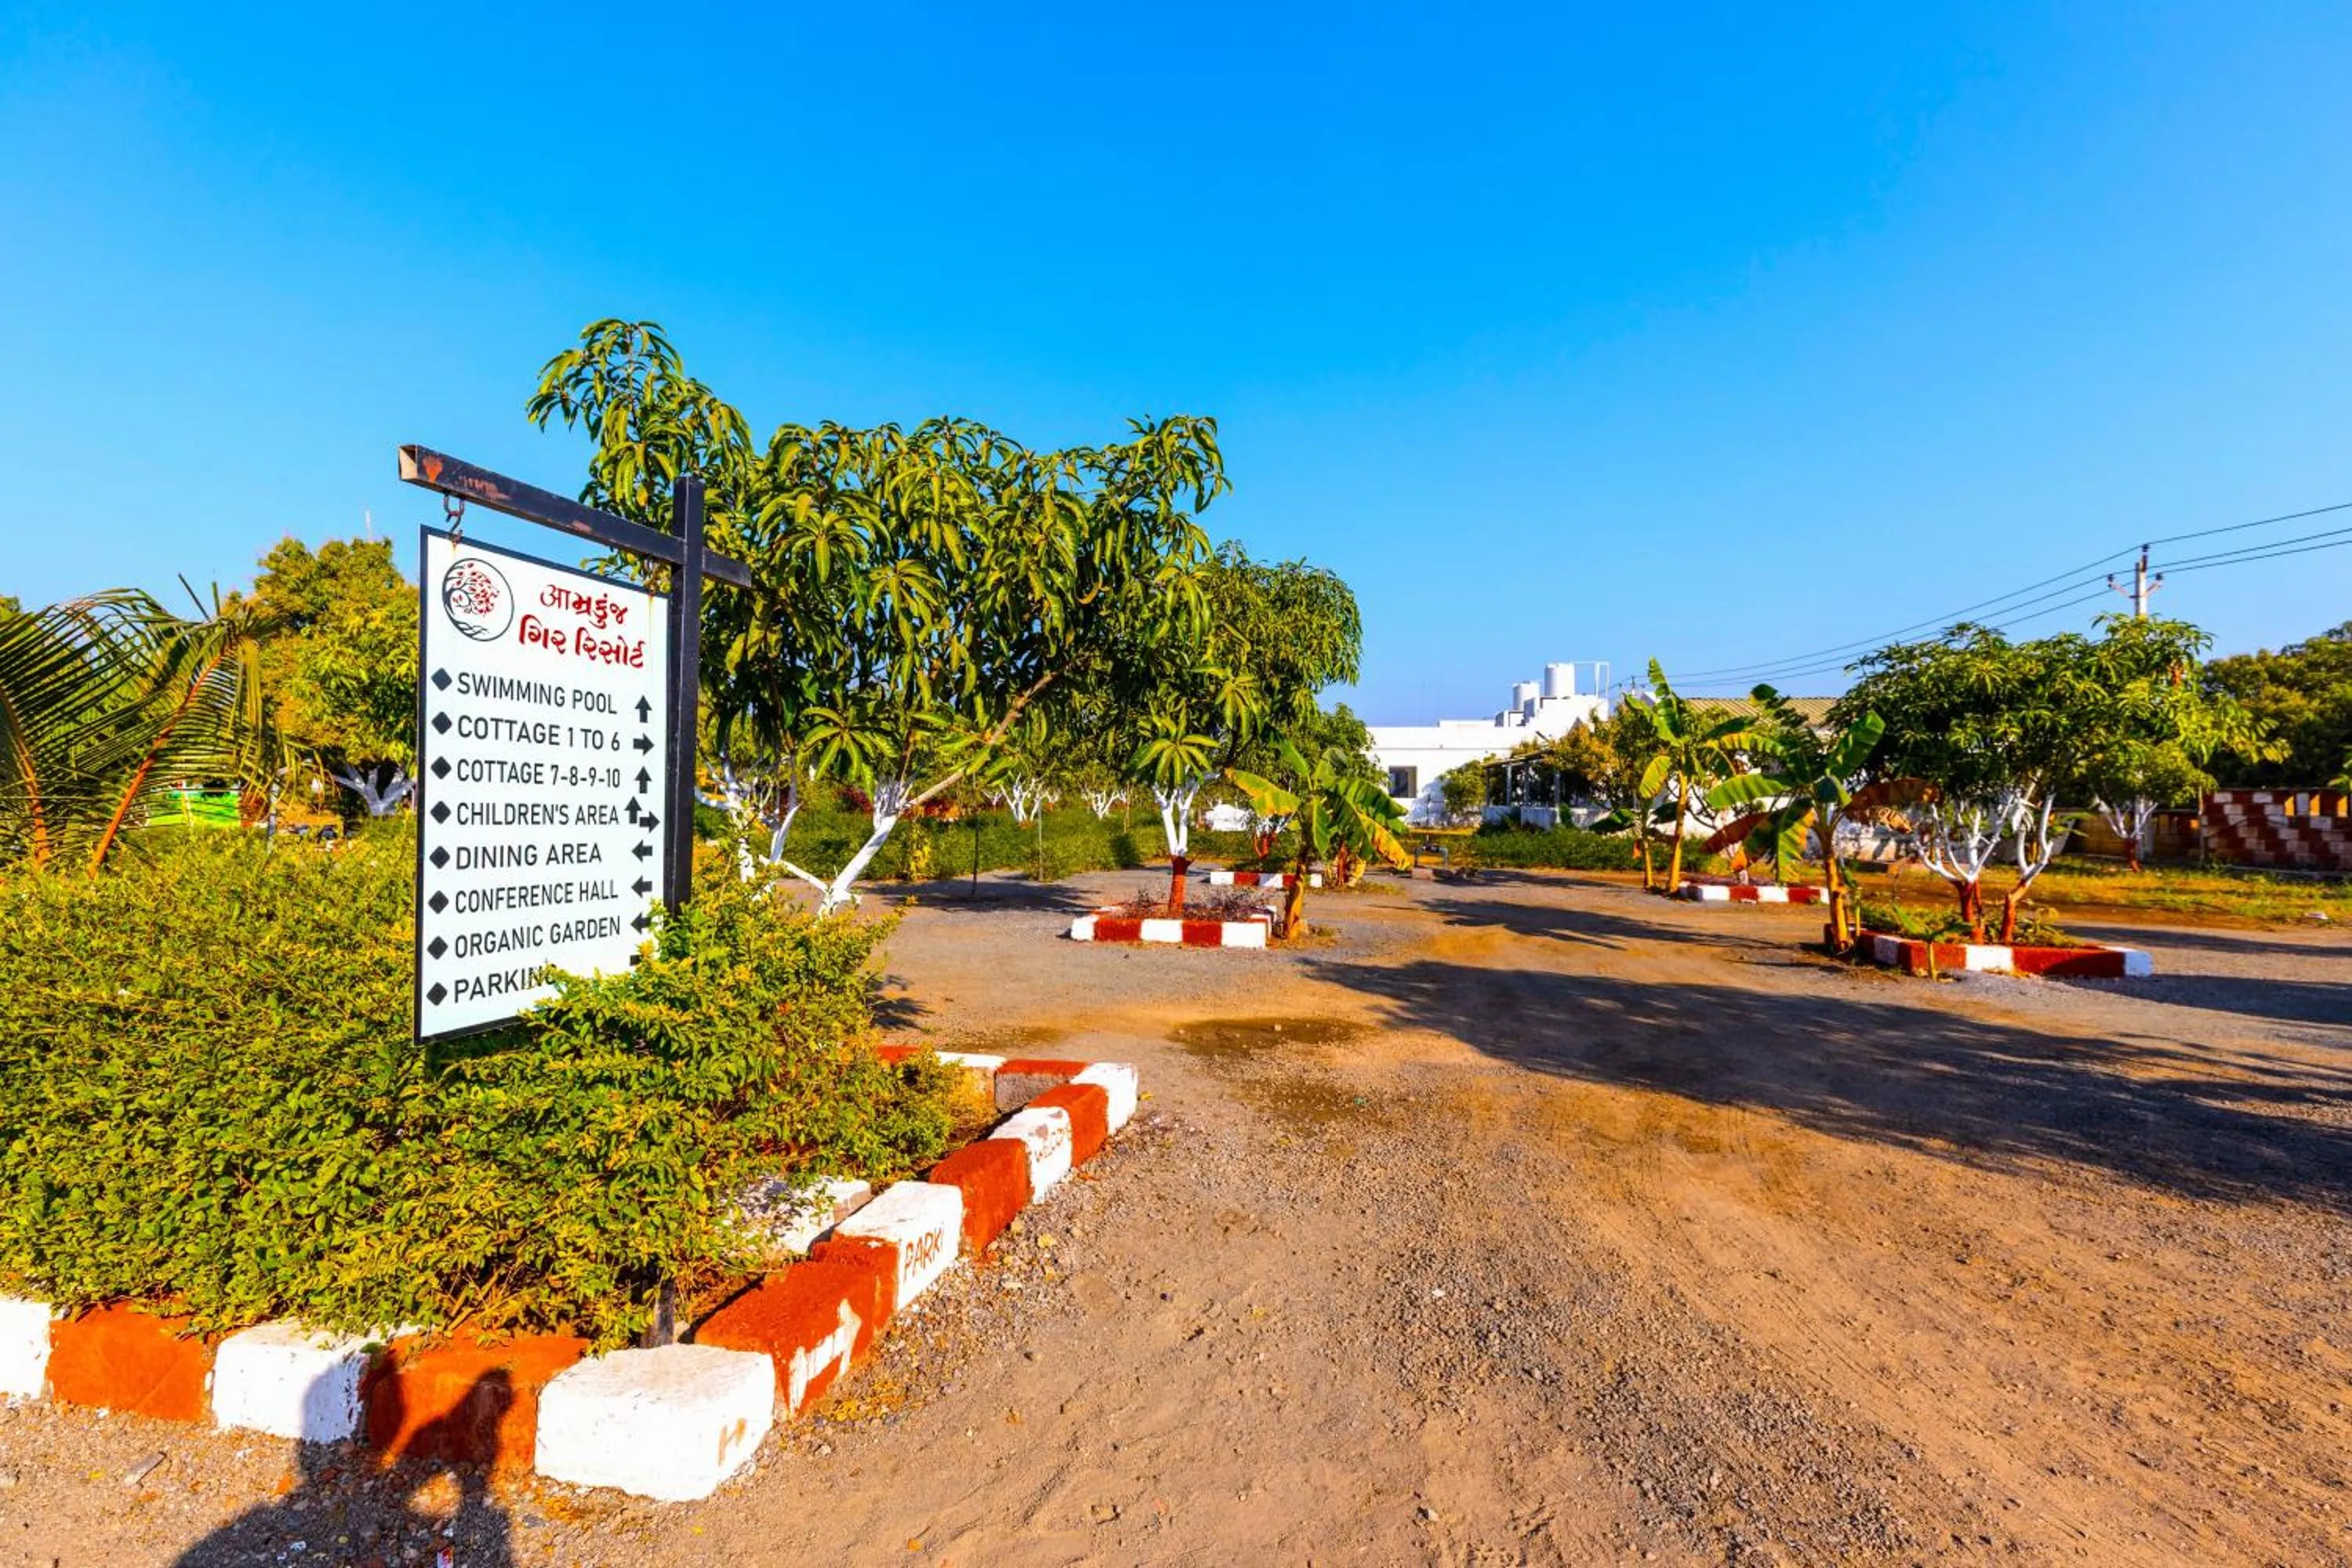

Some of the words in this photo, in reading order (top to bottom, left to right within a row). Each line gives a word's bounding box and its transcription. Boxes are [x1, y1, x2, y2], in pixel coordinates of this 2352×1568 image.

[519, 614, 566, 654] ગિર
[575, 627, 646, 668] રિસોર્ટ
[457, 672, 565, 707] SWIMMING
[572, 690, 618, 714] POOL
[458, 715, 561, 746] COTTAGE
[568, 727, 574, 747] 1
[580, 728, 604, 750] TO
[611, 731, 620, 751] 6
[457, 759, 544, 785] COTTAGE
[550, 764, 620, 788] 7-8-9-10
[456, 802, 569, 826] CHILDREN'S
[575, 805, 619, 826] AREA
[456, 844, 538, 869] DINING
[546, 842, 602, 866] AREA
[455, 883, 573, 913] CONFERENCE
[579, 880, 619, 900] HALL
[455, 926, 543, 958] ORGANIC
[550, 916, 621, 945] GARDEN
